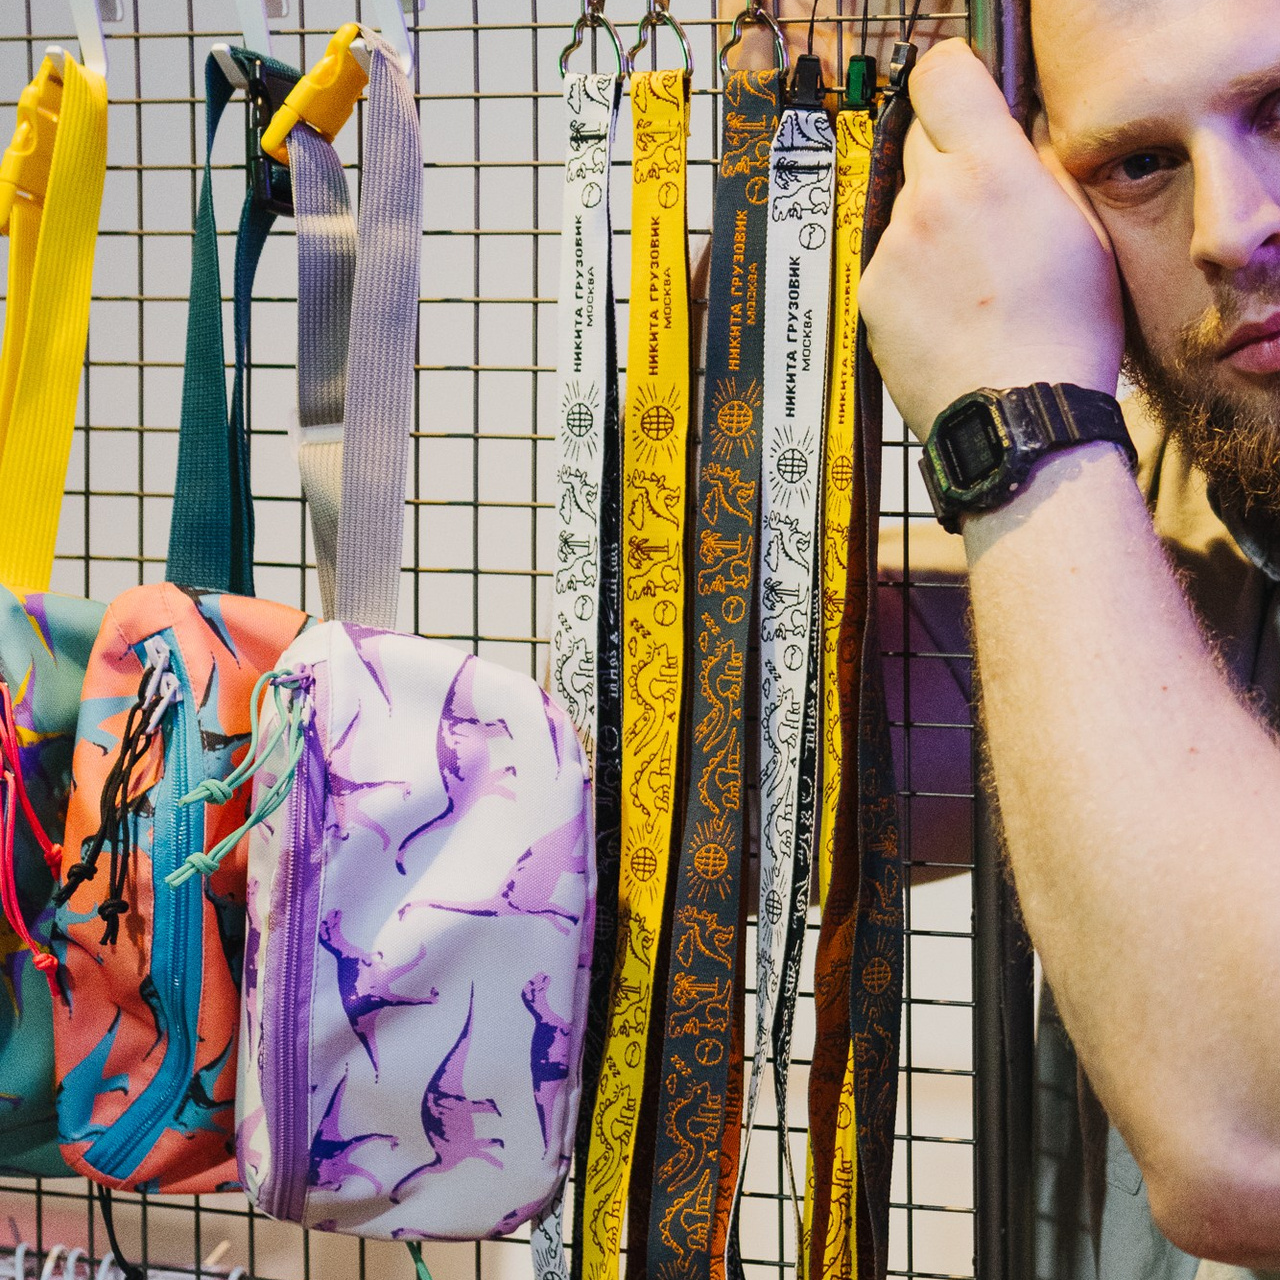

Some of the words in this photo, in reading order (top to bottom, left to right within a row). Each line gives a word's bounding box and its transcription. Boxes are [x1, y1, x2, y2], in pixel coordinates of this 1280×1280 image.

[574, 214, 584, 300] ГРУЗОВИК
[649, 215, 661, 302] ГРУЗОВИК
[730, 209, 748, 297] ГРУЗОВИК
[586, 266, 595, 327] МОСКВА
[663, 267, 672, 329] МОСКВА
[746, 262, 758, 325] МОСКВА
[786, 255, 801, 343] ГРУЗОВИК
[842, 262, 851, 349] ГРУЗОВИК
[573, 306, 584, 373] НИКИТА
[648, 309, 660, 376] НИКИТА
[728, 302, 743, 371] НИКИТА
[801, 308, 813, 372] МОСКВА
[785, 349, 798, 418] НИКИТА
[838, 358, 849, 425] НИКИТА
[987, 404, 1012, 449] G-SHOCK
